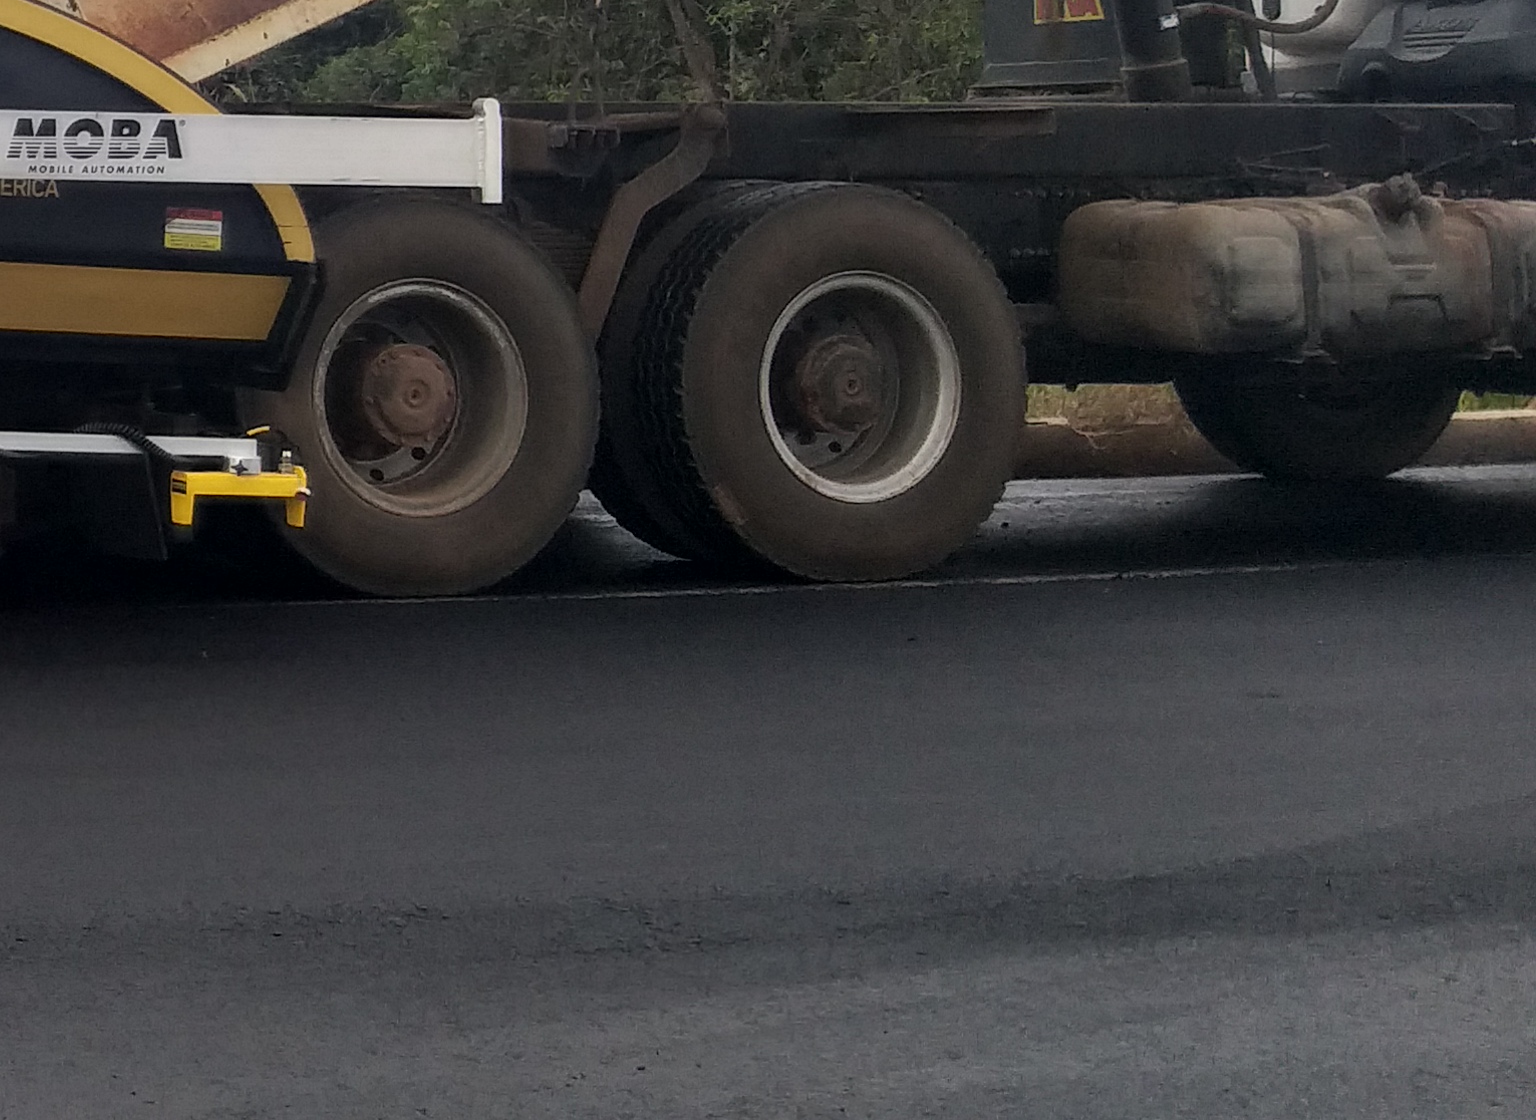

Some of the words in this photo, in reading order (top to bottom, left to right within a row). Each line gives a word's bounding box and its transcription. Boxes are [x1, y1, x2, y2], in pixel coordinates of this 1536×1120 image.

[6, 118, 183, 160] MOBA
[27, 164, 74, 174] MOBILE
[81, 165, 166, 175] AUTOMATION
